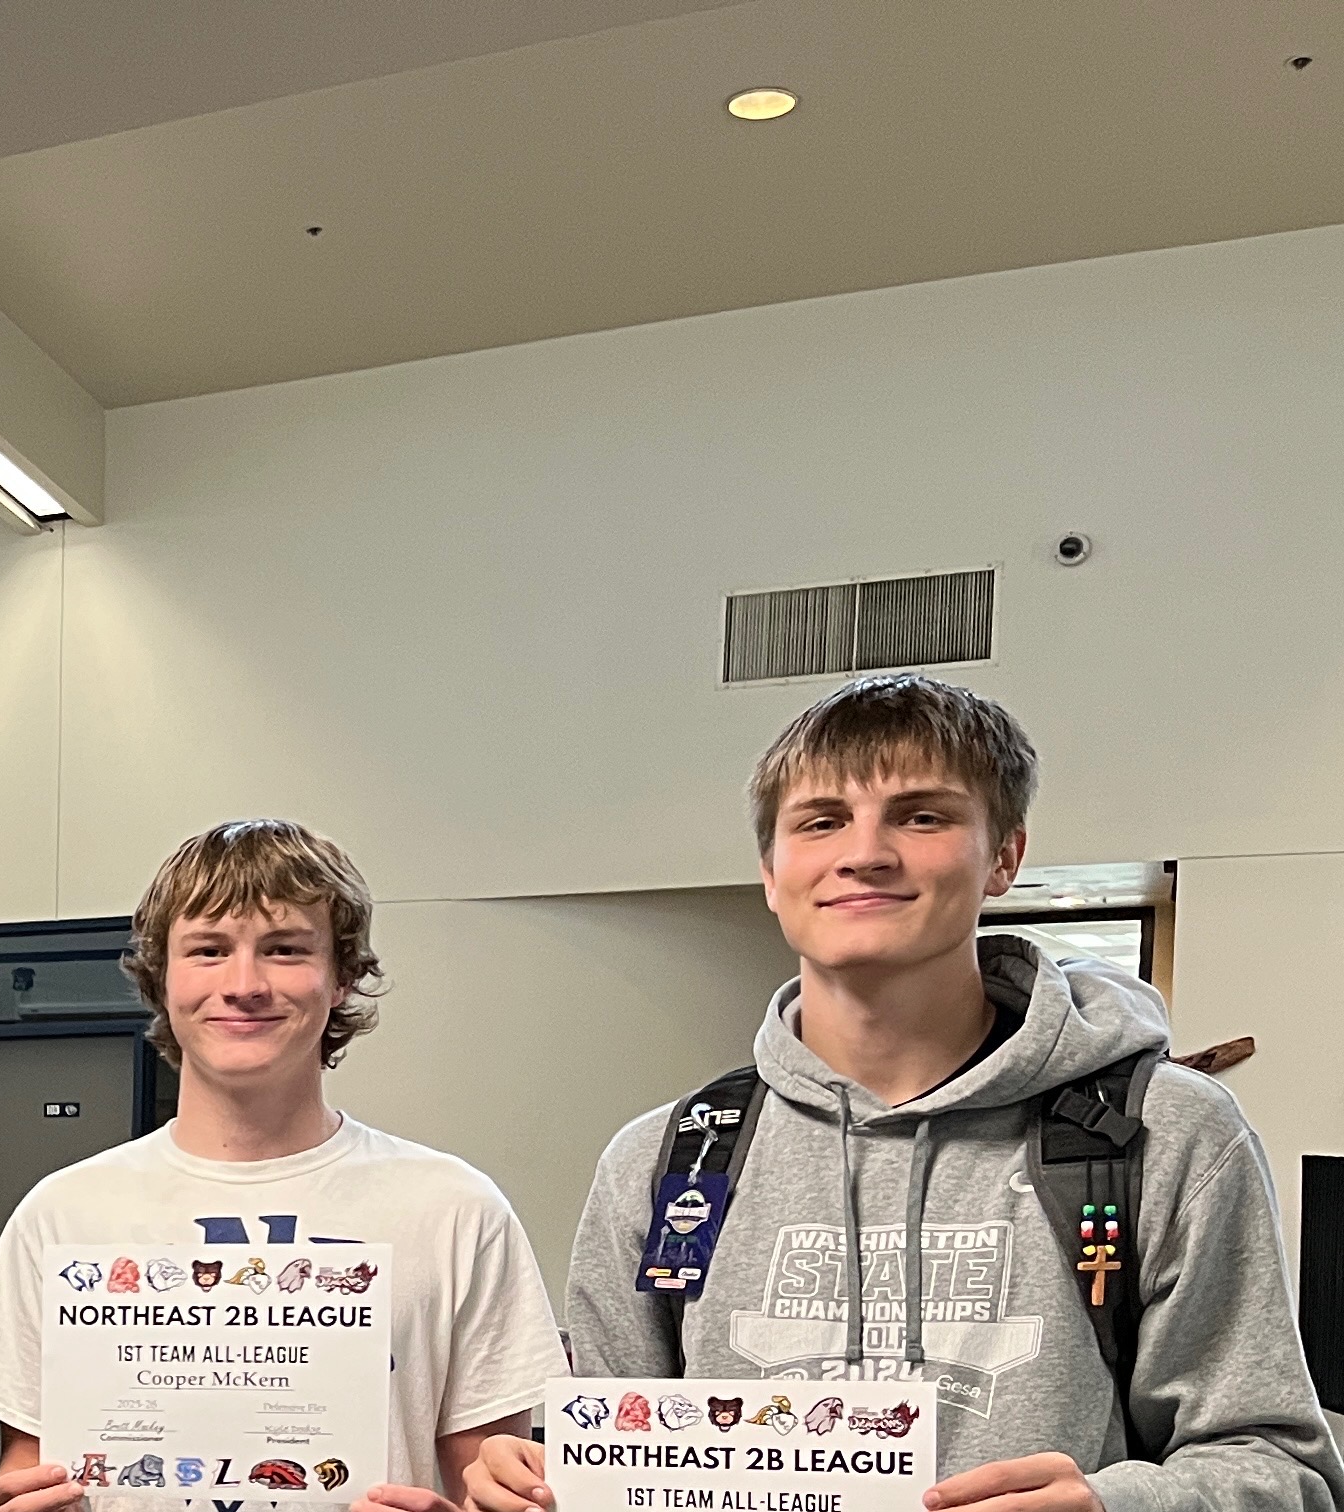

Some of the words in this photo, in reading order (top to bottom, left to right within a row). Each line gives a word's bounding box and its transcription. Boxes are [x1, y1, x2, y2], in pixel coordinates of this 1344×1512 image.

[778, 1249, 997, 1299] STATE
[59, 1306, 216, 1326] NORTHEAST
[224, 1306, 258, 1326] 2B
[268, 1306, 372, 1327] LEAGUE
[118, 1345, 143, 1362] 1ST
[150, 1345, 195, 1362] TEAM
[202, 1346, 309, 1363] ALL-LEAGUE
[136, 1370, 206, 1390] Cooper
[212, 1372, 289, 1387] McKern
[936, 1374, 981, 1398] Gesa
[563, 1444, 736, 1469] NORTHEAST
[745, 1448, 784, 1470] 2B
[794, 1449, 913, 1475] LEAGUE
[627, 1488, 655, 1506] 1ST
[663, 1489, 713, 1509] TEAM
